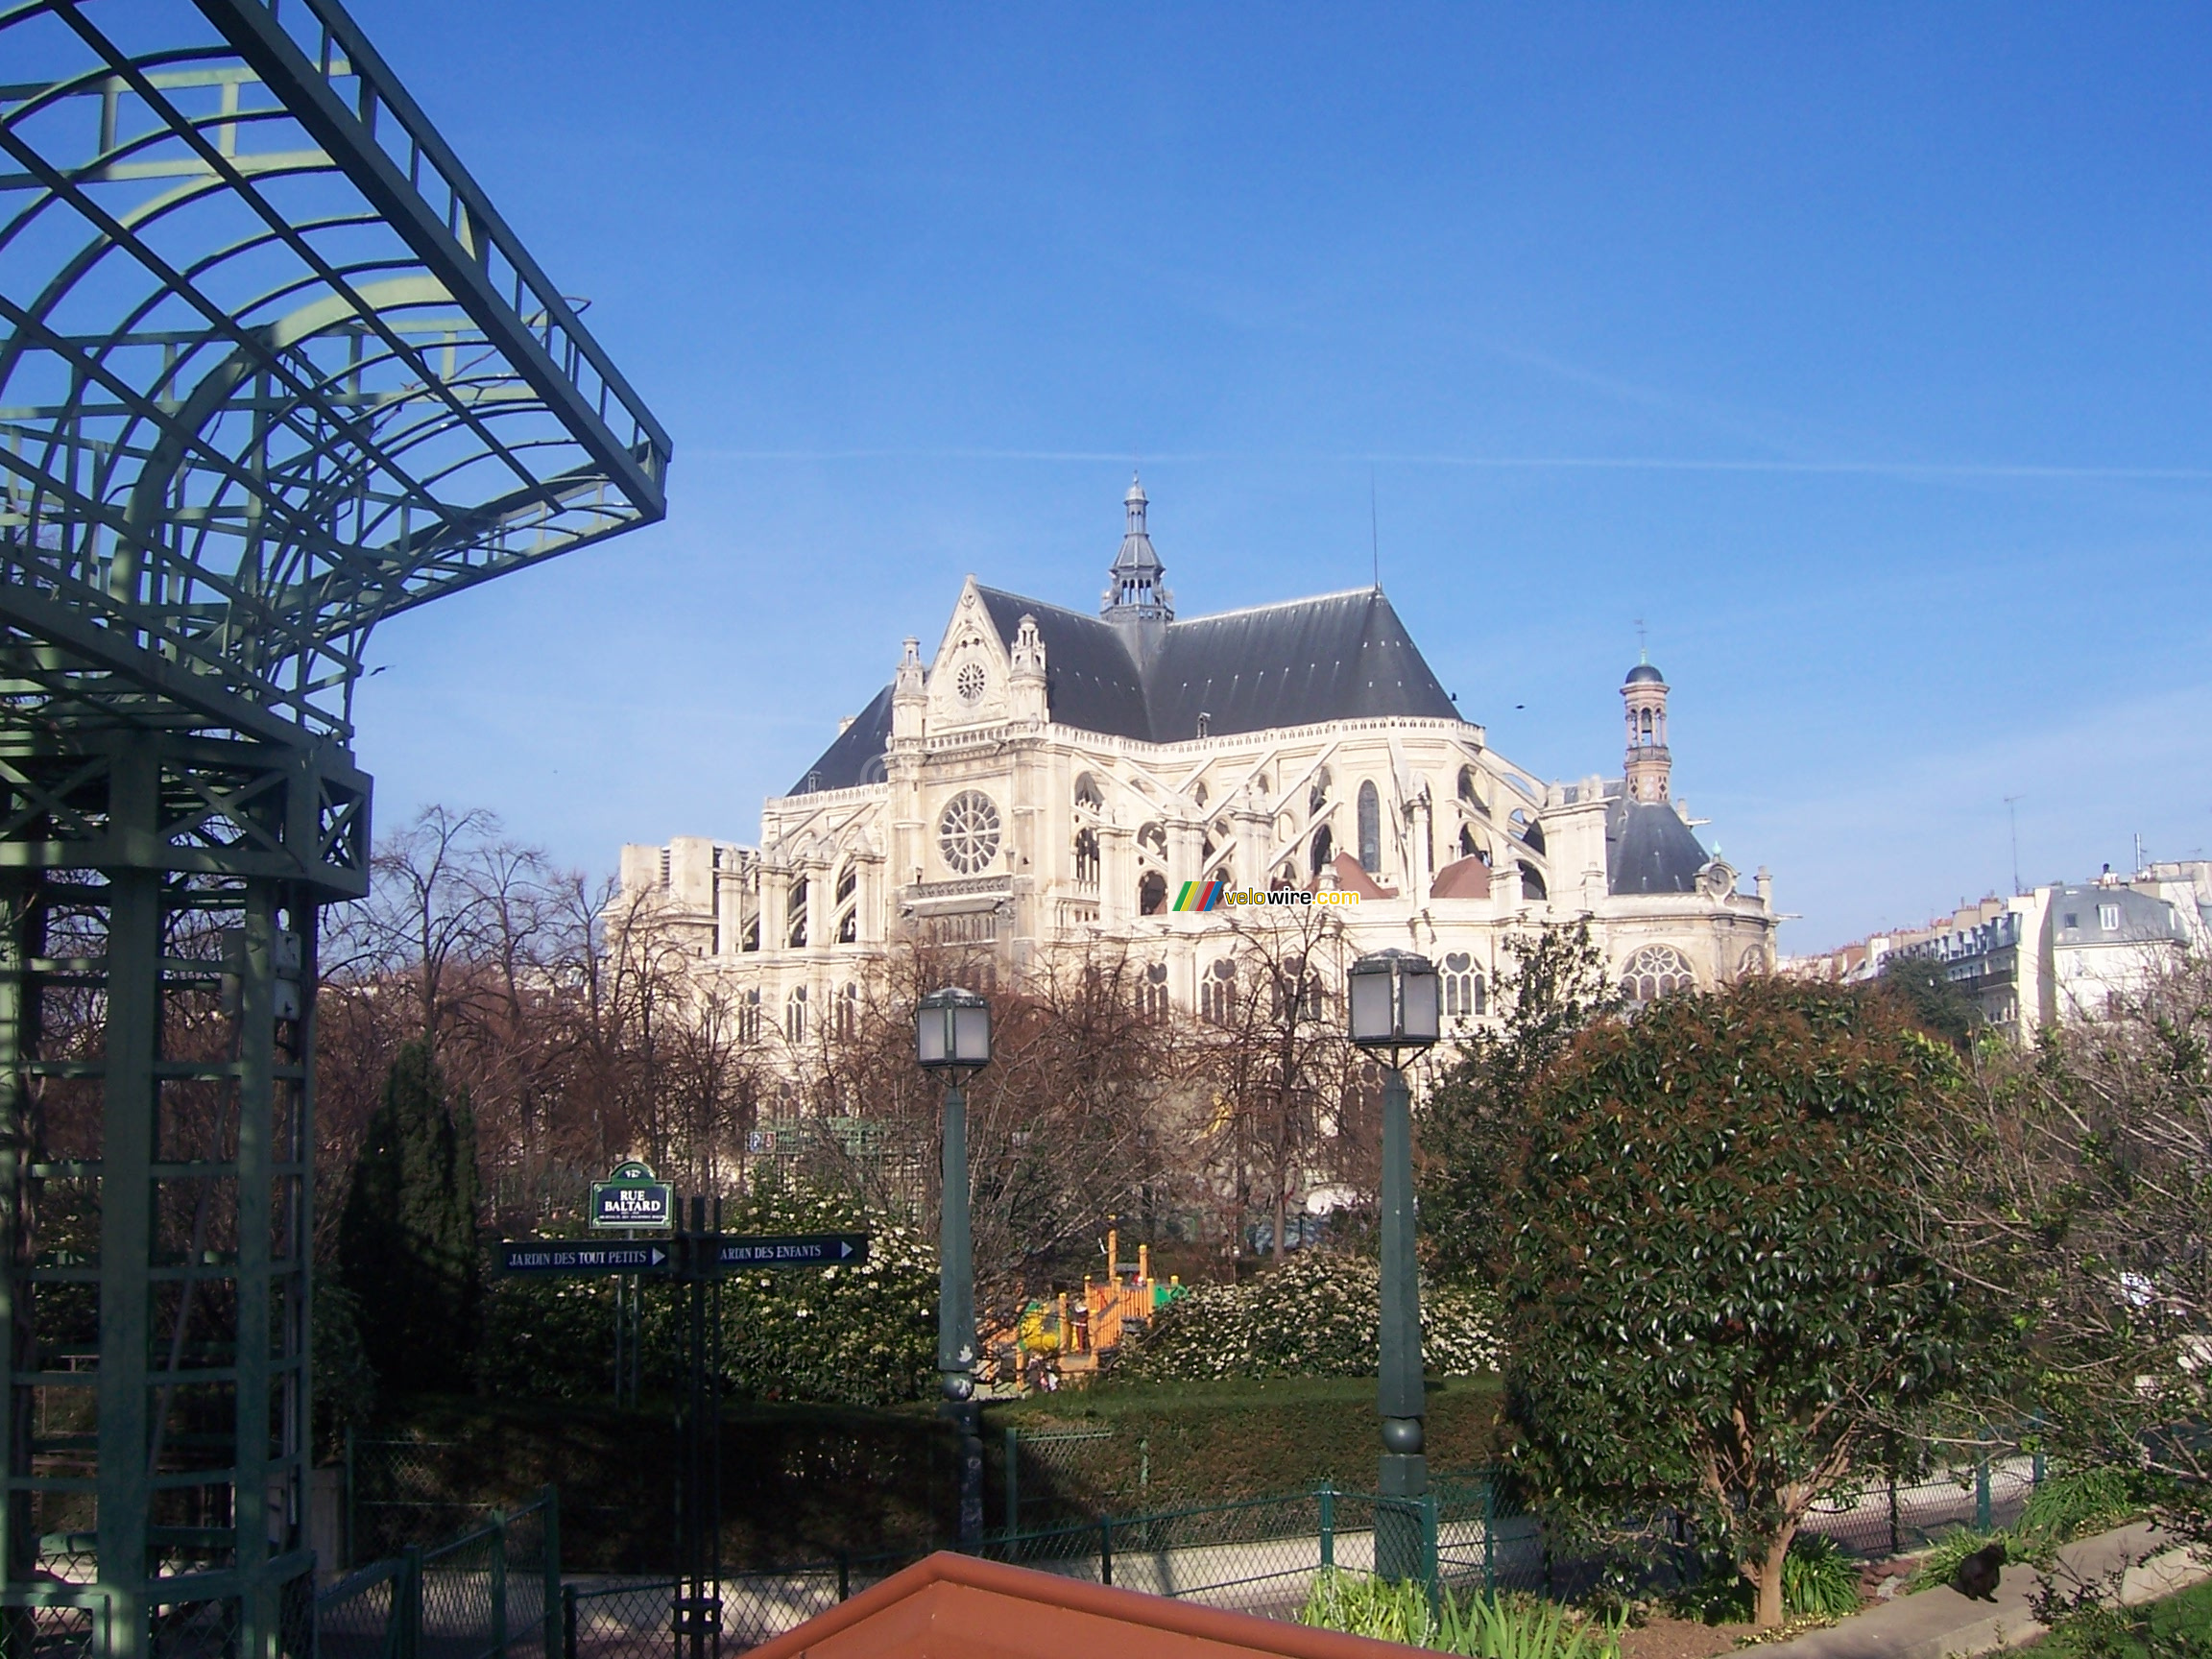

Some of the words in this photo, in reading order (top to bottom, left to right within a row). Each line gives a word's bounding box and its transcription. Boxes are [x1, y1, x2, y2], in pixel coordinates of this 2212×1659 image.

[620, 1190, 645, 1201] RUE
[604, 1200, 661, 1212] BALTARD
[509, 1252, 551, 1266] JARDIN
[554, 1252, 576, 1265] DES
[578, 1251, 606, 1264] TOUT
[608, 1250, 647, 1263] PETITS
[720, 1247, 752, 1260] ARDIN
[755, 1246, 774, 1259] DES
[777, 1245, 822, 1258] ENFANTS
